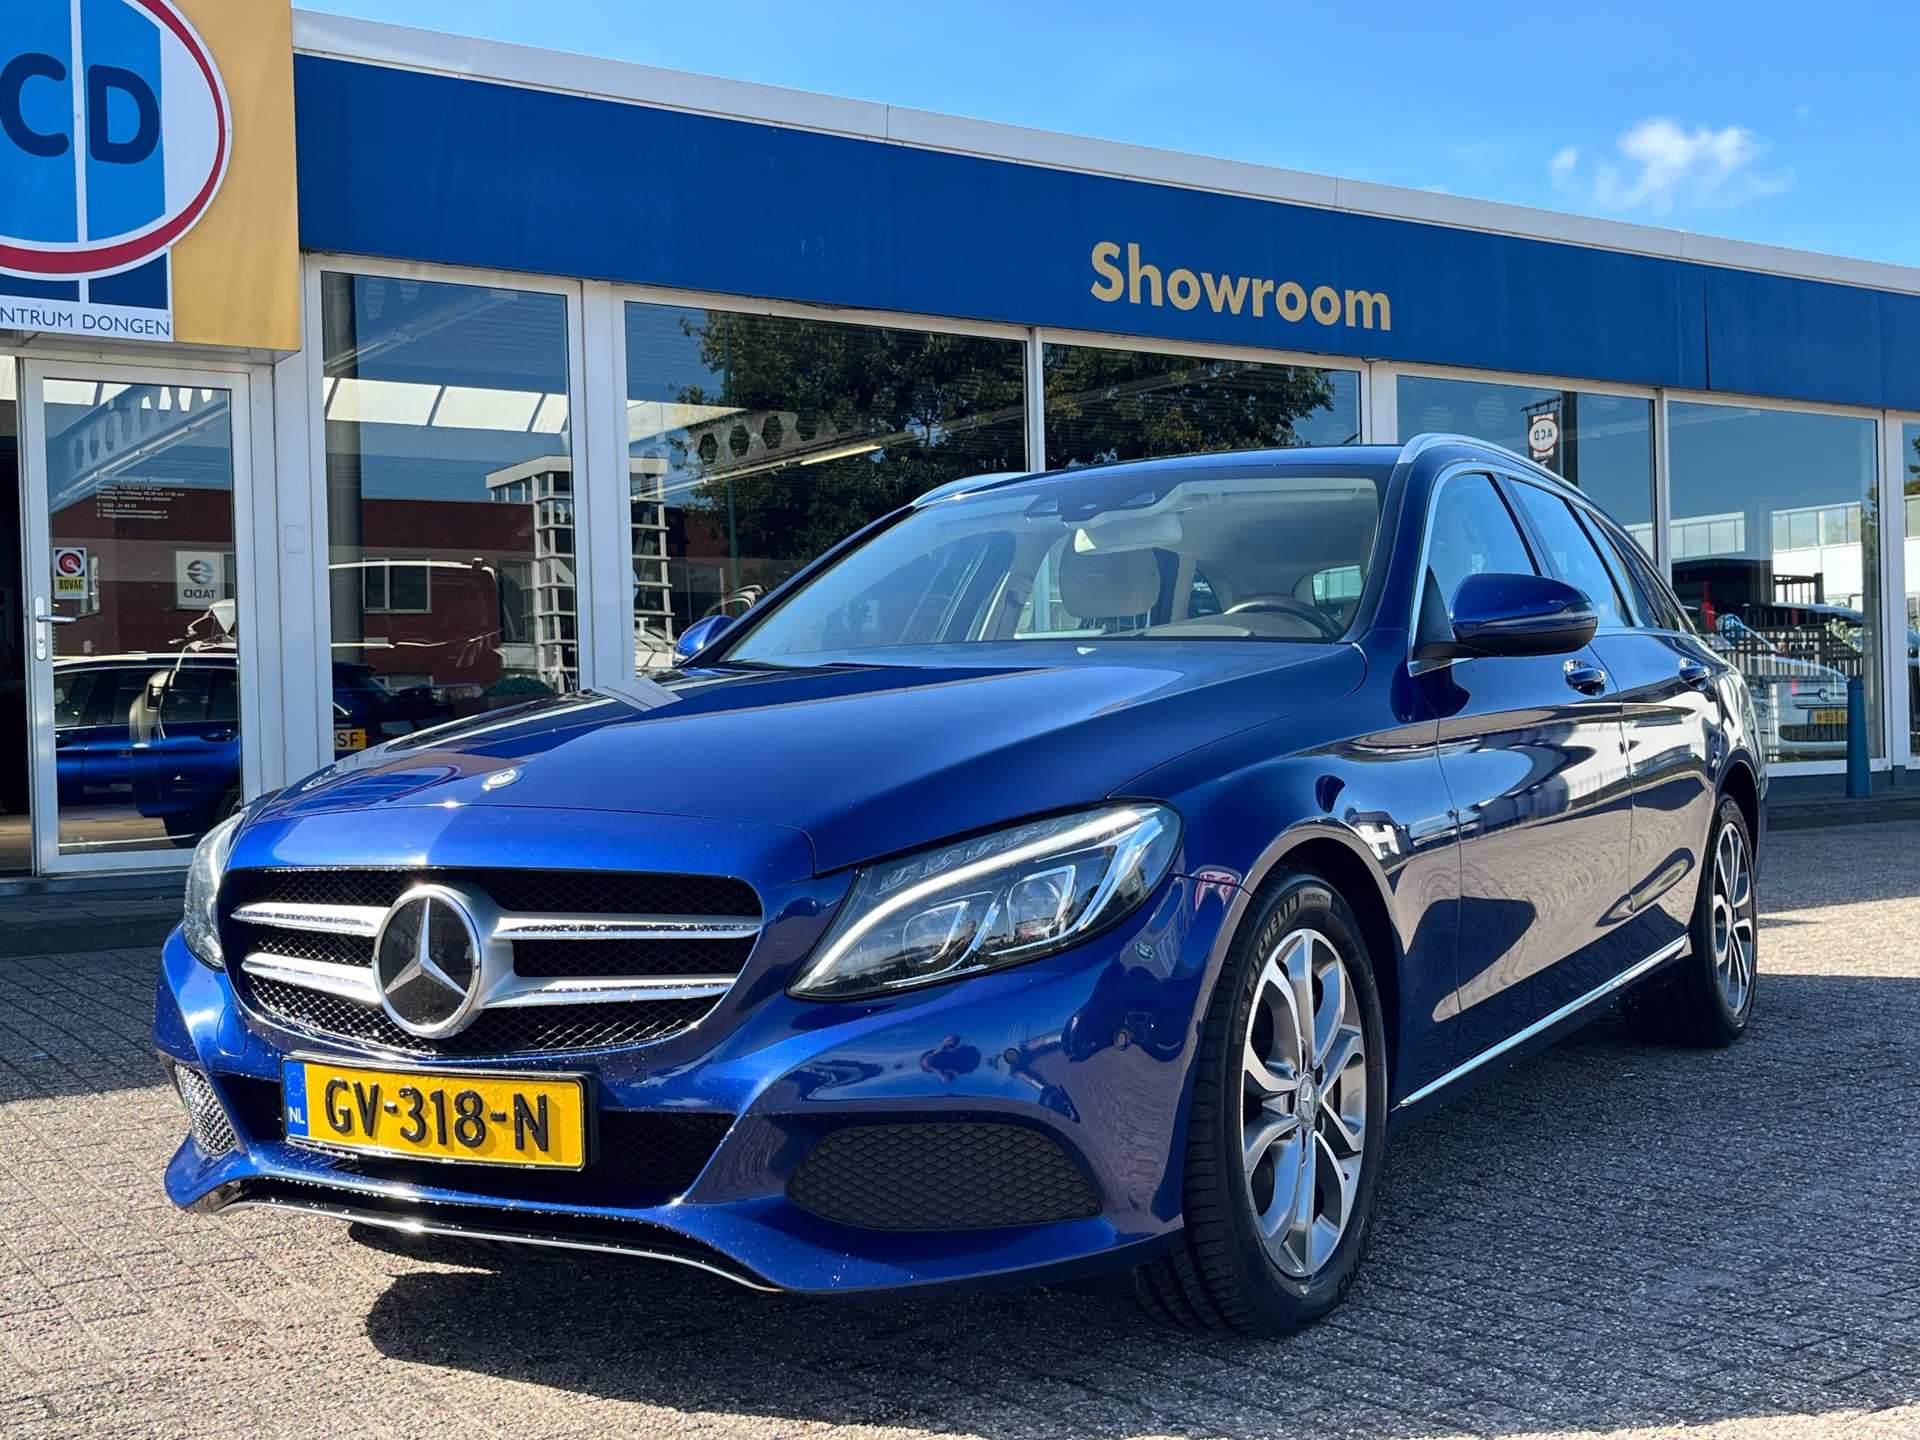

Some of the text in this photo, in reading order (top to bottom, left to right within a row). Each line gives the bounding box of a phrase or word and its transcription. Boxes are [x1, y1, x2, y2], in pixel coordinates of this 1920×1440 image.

[1090, 241, 1391, 331] Showroom
[82, 314, 170, 336] DONGEN
[58, 579, 84, 591] BOVAG
[289, 1105, 306, 1125] NL
[325, 1076, 550, 1152] GV-318-N
